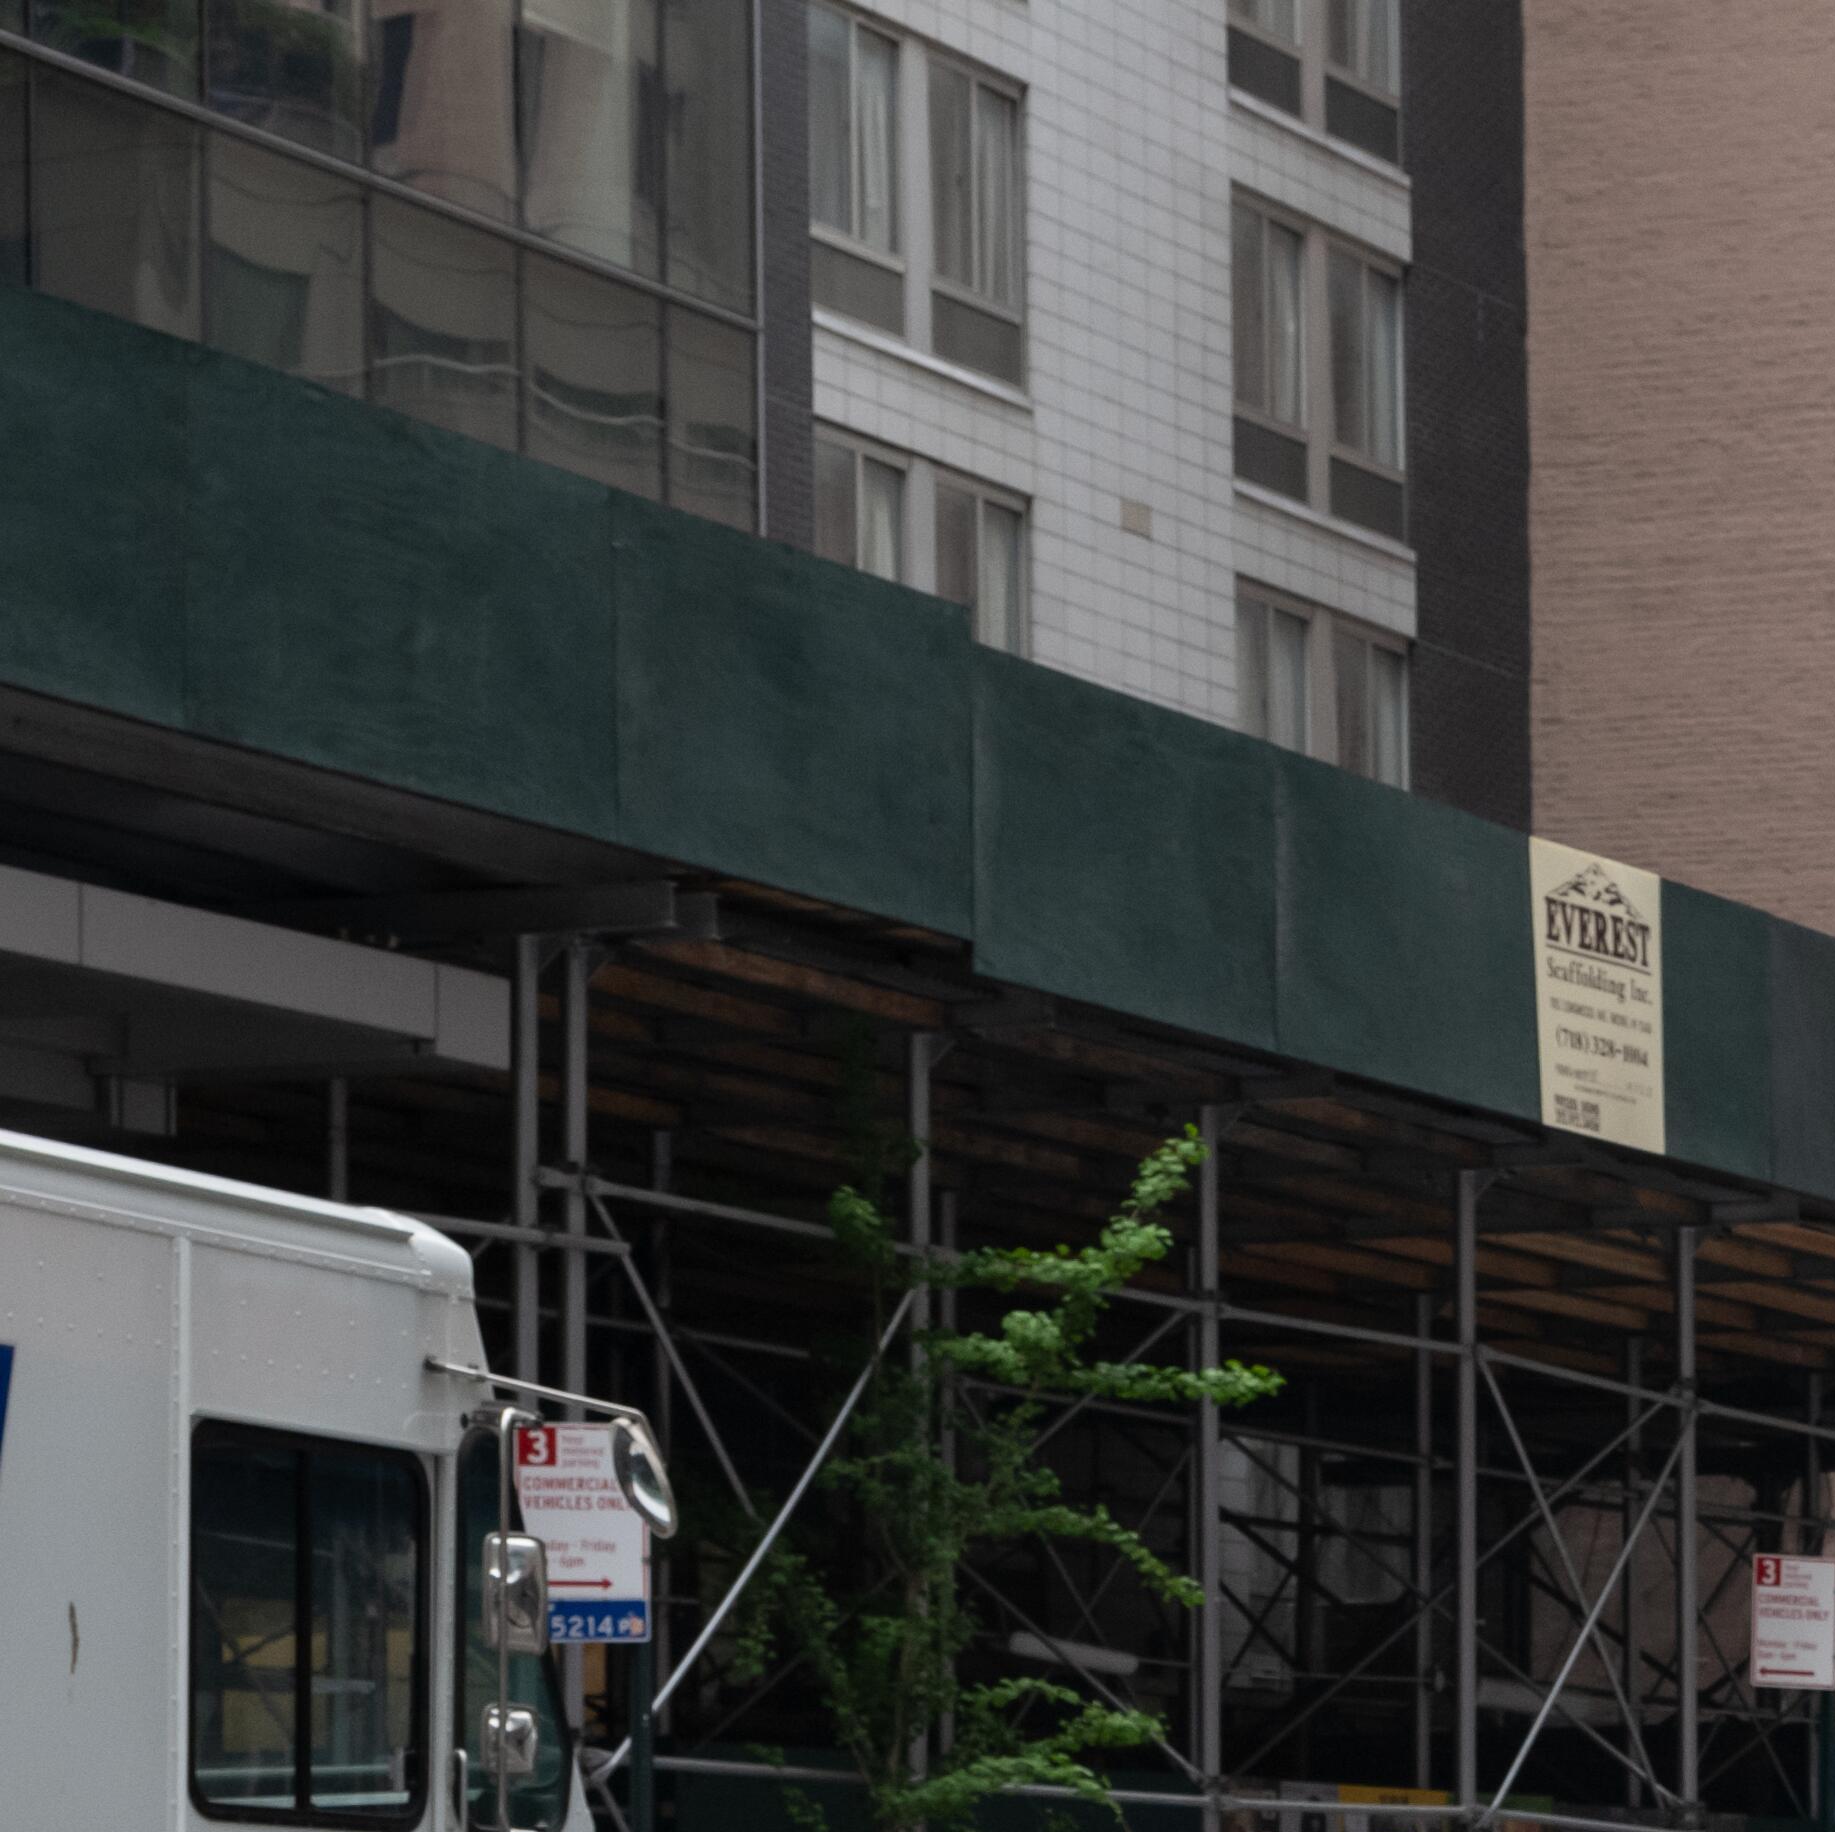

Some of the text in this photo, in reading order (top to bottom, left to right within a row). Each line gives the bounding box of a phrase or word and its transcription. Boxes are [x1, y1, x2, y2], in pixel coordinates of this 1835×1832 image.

[1545, 896, 1651, 967] EVEREST
[526, 1429, 548, 1465] 3
[523, 1476, 618, 1492] COMMERCIAL
[524, 1496, 633, 1512] VEHICLES ONL
[1761, 1559, 1778, 1584] 3
